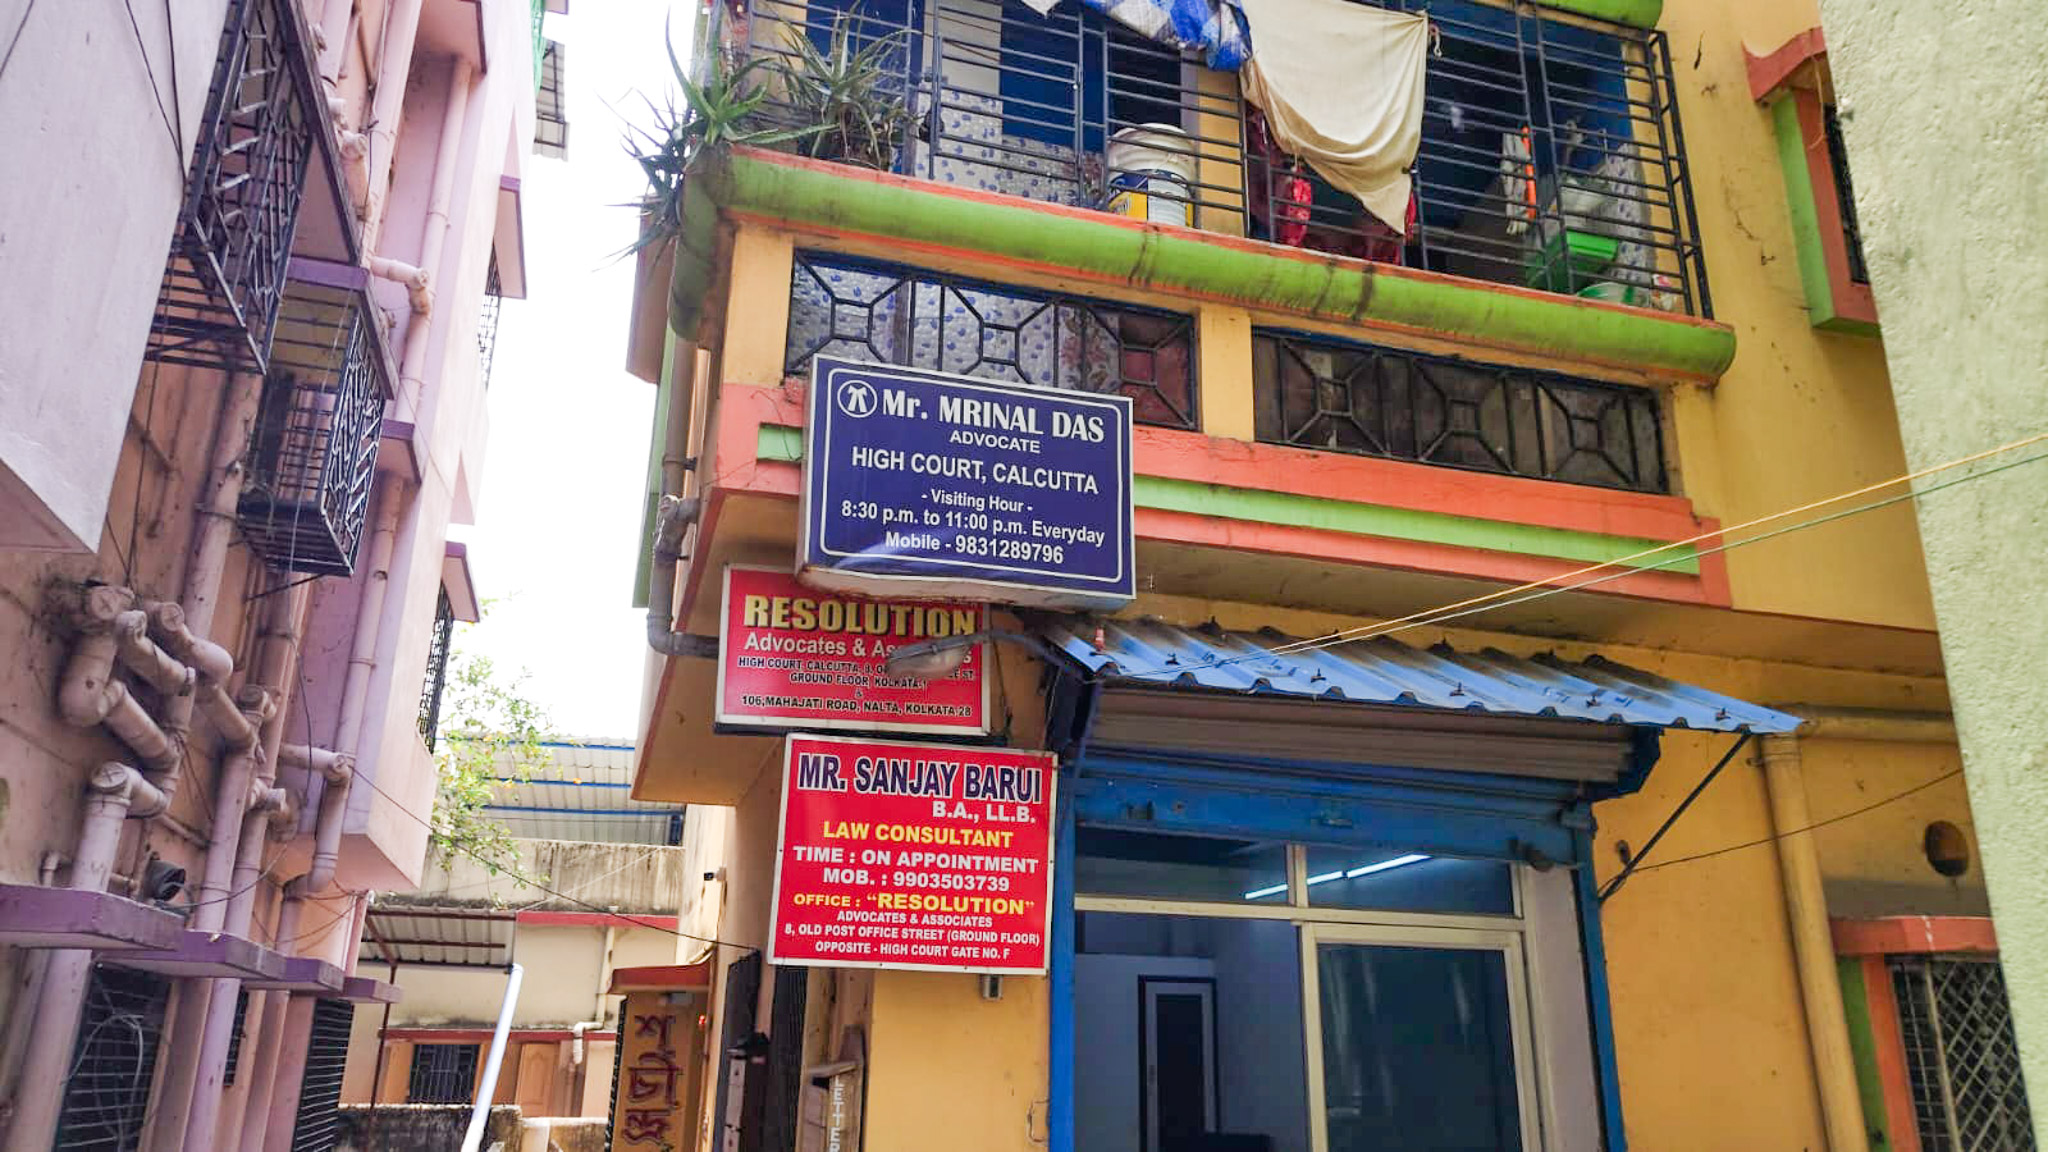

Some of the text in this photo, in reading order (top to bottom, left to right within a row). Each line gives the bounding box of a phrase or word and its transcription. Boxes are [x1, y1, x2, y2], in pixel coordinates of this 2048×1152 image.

[882, 388, 1105, 443] Mr. MRINAL DAS
[950, 430, 1041, 454] ADVOCATE
[851, 446, 1099, 495] HIGH COURT, CALCUTTA
[931, 489, 985, 513] Visiting
[989, 498, 1024, 514] Hour
[841, 500, 1105, 547] 8:30 p.m. to 11:00 p.m. Everyday
[885, 531, 941, 551] Mobile
[955, 534, 1064, 565] 9831289796
[743, 594, 978, 638] RESOLUTION
[744, 631, 847, 657] Advocates
[854, 638, 867, 658] &
[738, 656, 765, 669] HIGH
[790, 672, 833, 685] GROUND
[797, 752, 1042, 805] MR. SANJAY BARUI
[932, 801, 1036, 823] B.A., LL.B.
[823, 821, 1014, 849] LAW CONSULTANT
[793, 845, 844, 864] TIME
[861, 849, 891, 866] ON
[897, 851, 1039, 874] APPOINTMENT
[823, 867, 875, 886] MOB.
[893, 870, 1010, 892] 9903503739
[793, 893, 851, 908] OFFICE
[837, 911, 993, 928] ADVOCATES & ASSOCIATES
[799, 924, 822, 937] OLD
[825, 925, 856, 938] POST
[858, 926, 899, 939] OFFICE
[901, 928, 945, 941] STREET
[947, 929, 998, 943] (GROUND
[1000, 932, 1041, 946] FLOOR)
[815, 941, 871, 955] OPPOSITE
[880, 944, 908, 956] HIGH
[911, 944, 949, 957] COURT
[951, 945, 980, 958] GATE
[982, 947, 1001, 959] NO.
[1003, 948, 1011, 960] F
